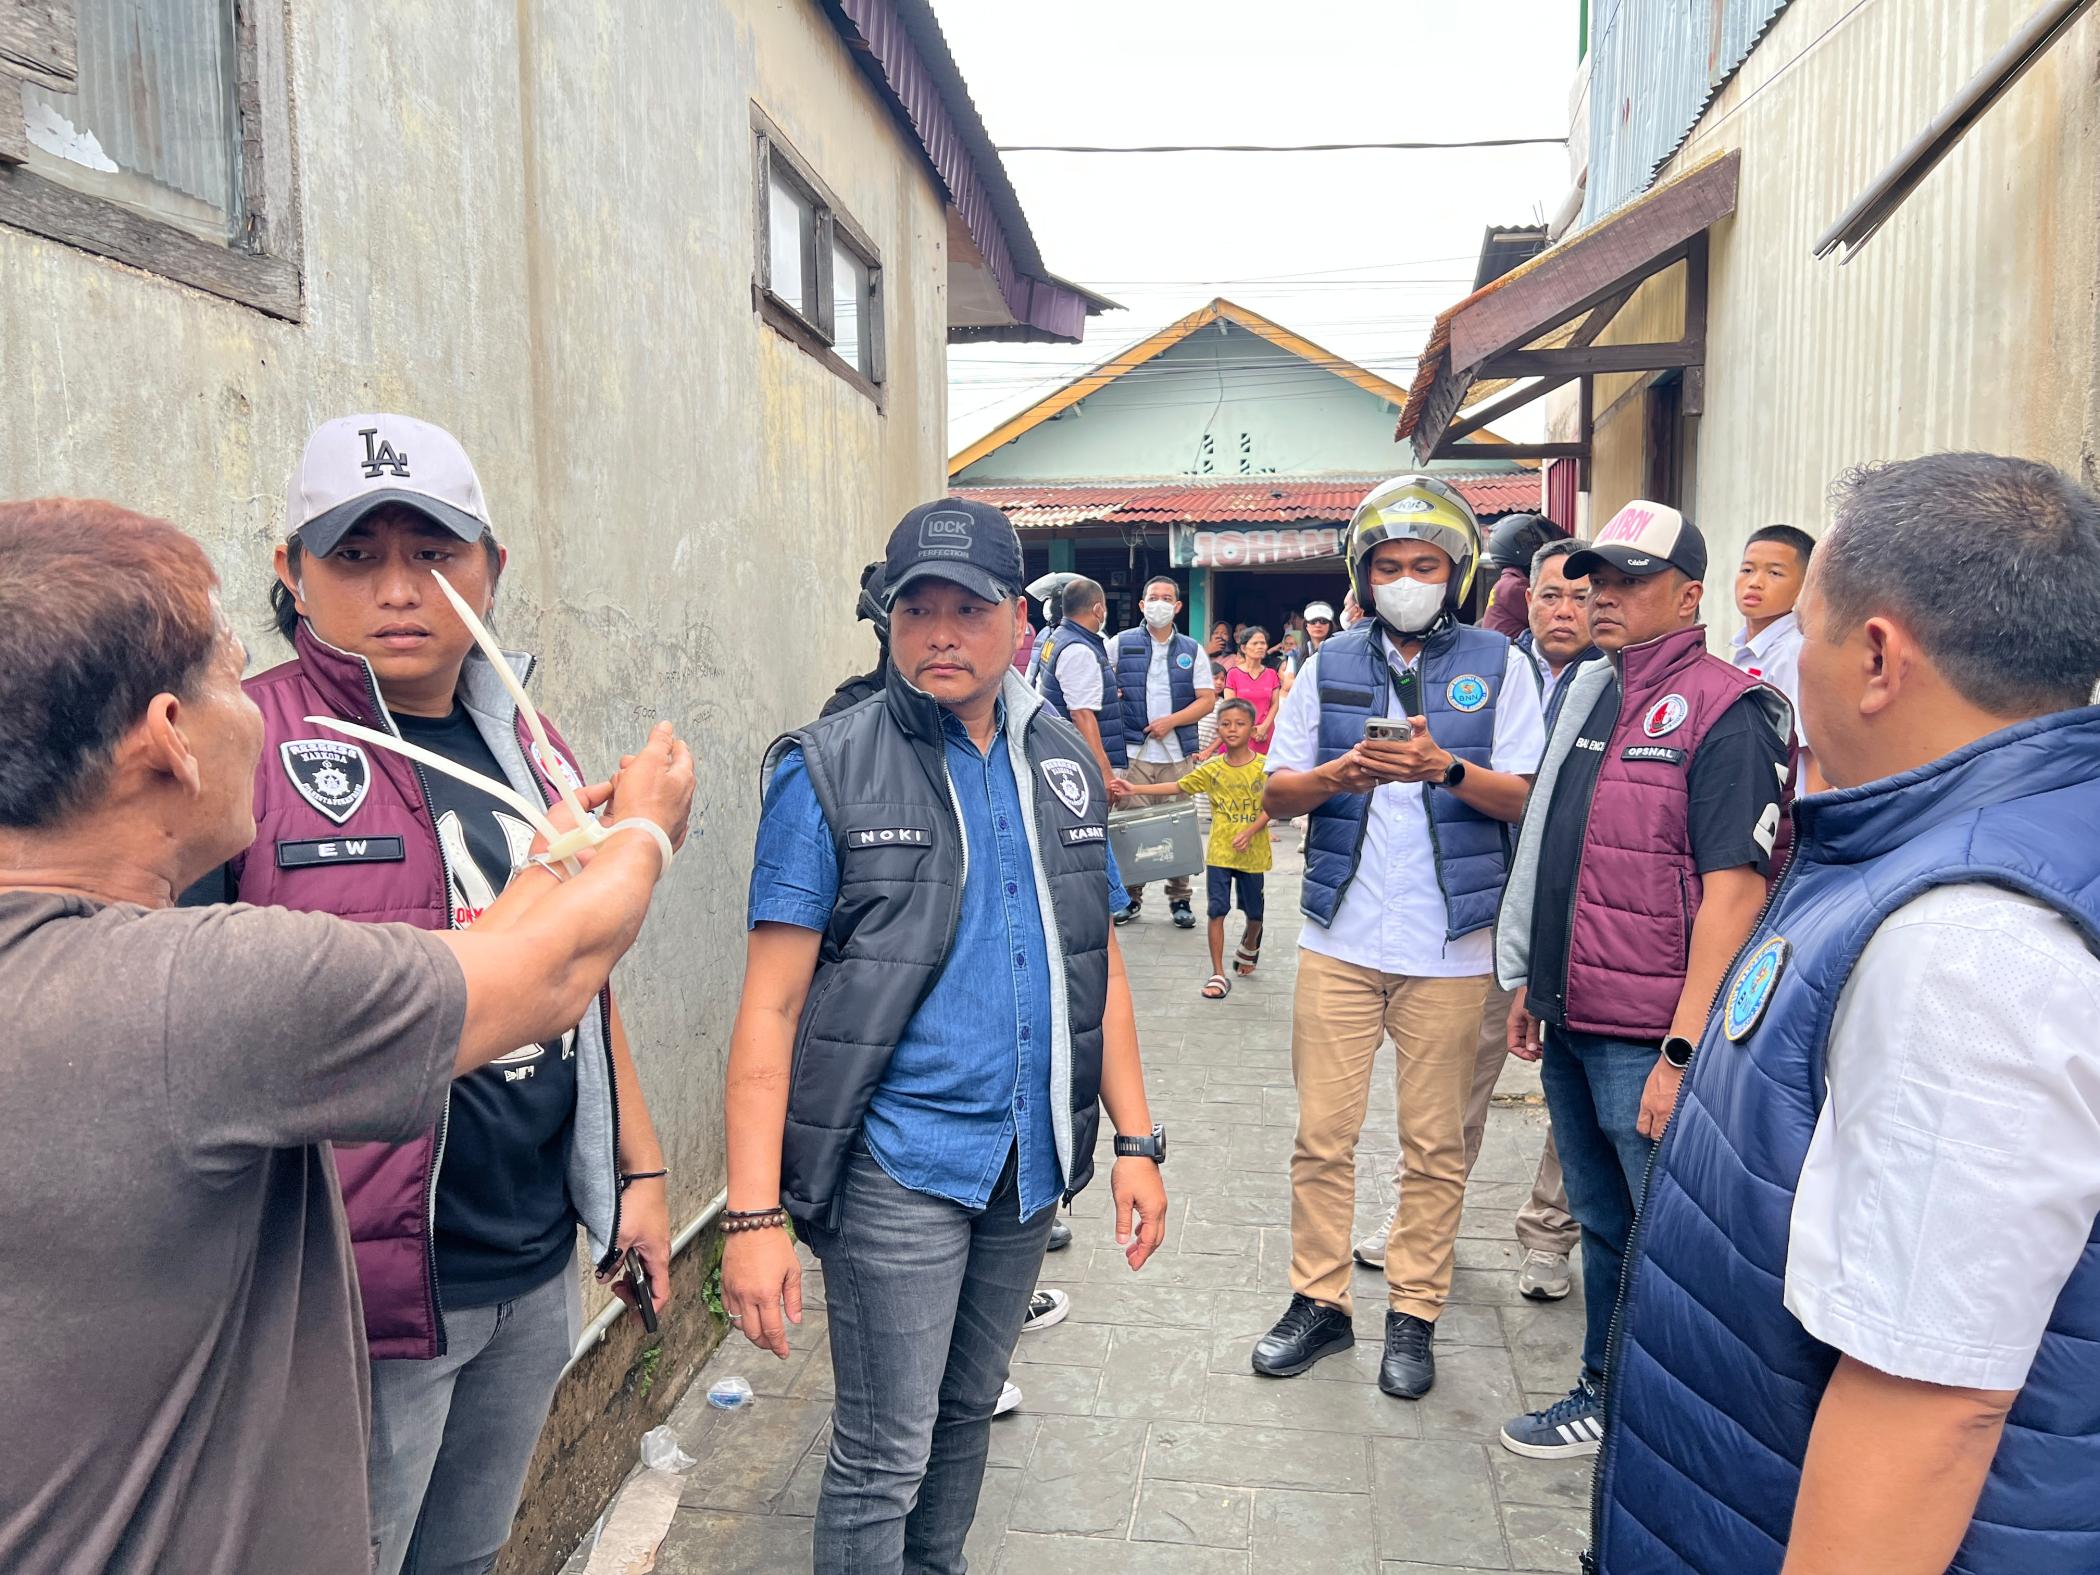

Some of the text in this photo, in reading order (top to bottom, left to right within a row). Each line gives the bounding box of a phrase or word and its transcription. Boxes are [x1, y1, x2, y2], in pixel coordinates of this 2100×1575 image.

[358, 428, 410, 478] LA
[918, 549, 969, 558] PERFECTION
[1192, 529, 1340, 568] JOHAN
[1459, 694, 1478, 702] BNN
[1628, 747, 1673, 758] OPSNAL
[860, 829, 921, 844] NOKI
